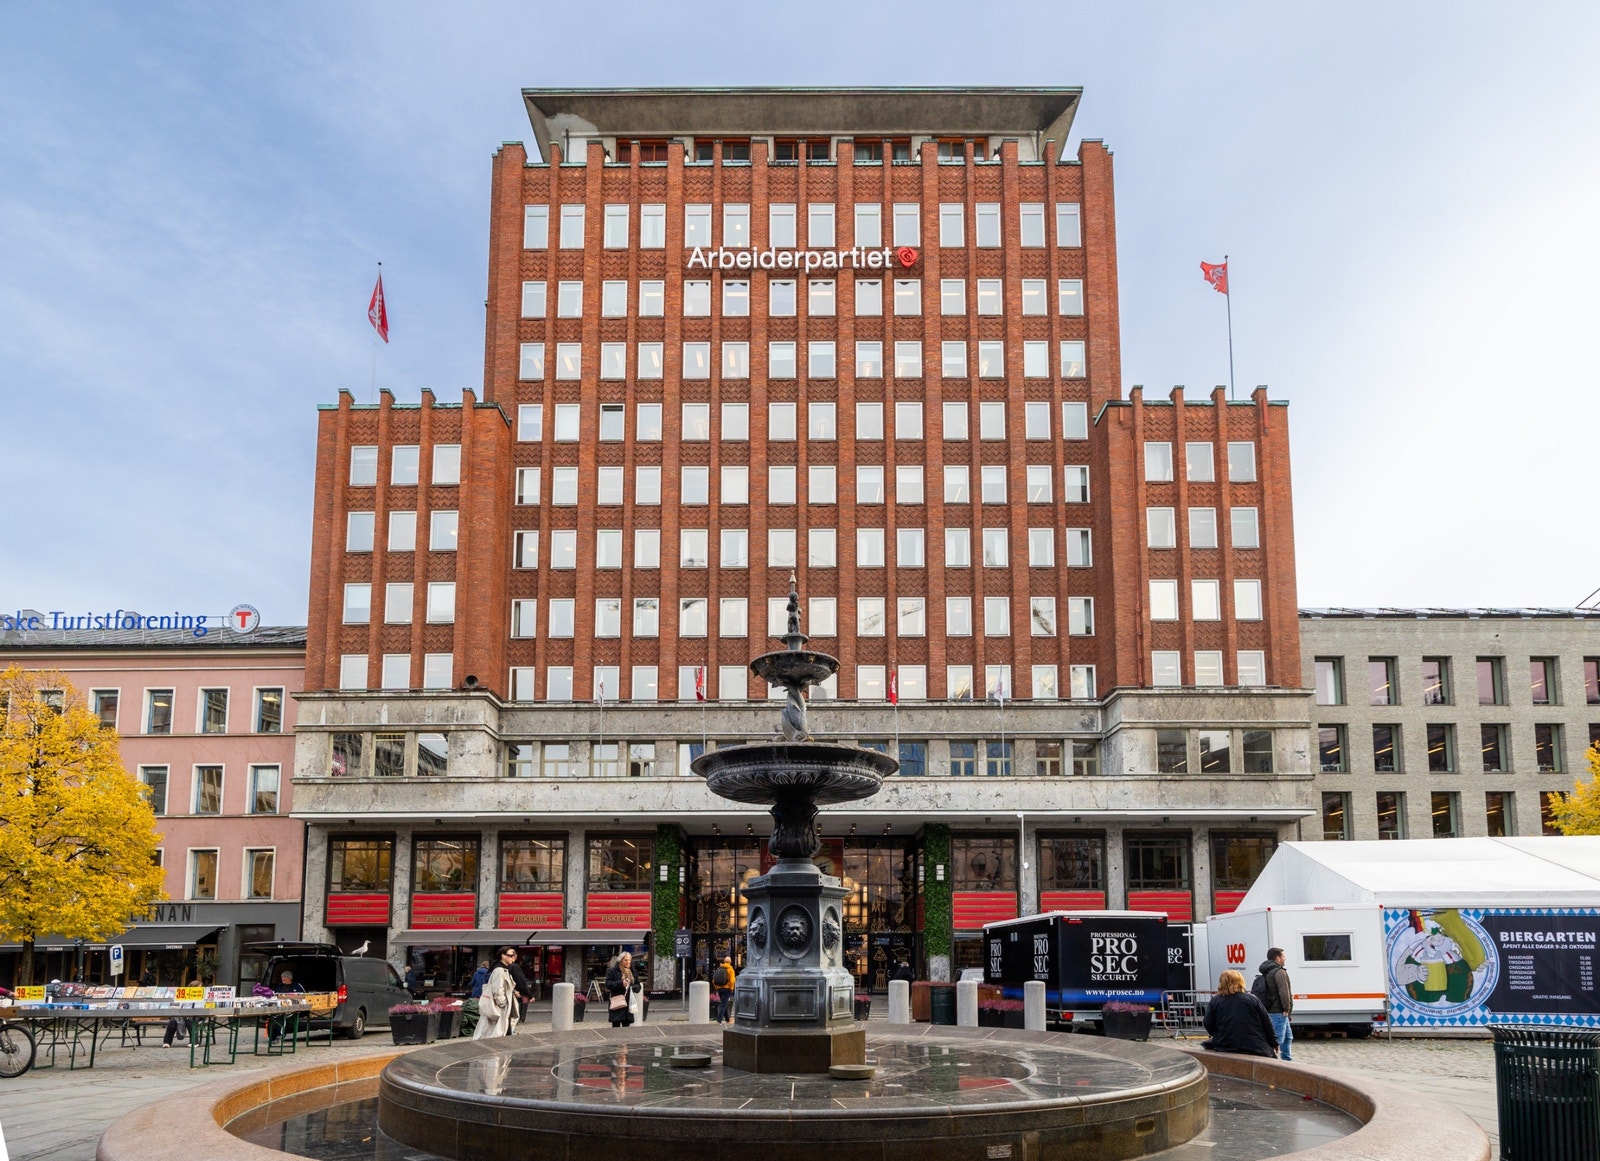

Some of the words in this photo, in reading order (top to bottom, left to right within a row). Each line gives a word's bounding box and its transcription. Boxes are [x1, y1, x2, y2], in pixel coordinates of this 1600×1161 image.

[687, 246, 892, 274] Arbeiderpartiet
[0, 610, 40, 631] ske
[49, 609, 208, 637] Turistforening
[513, 915, 548, 923] FISKERIET
[601, 915, 636, 923] FISKERIET
[1500, 931, 1596, 942] BIERGARTEN
[990, 943, 1002, 957] PRO
[1033, 938, 1049, 955] PRO
[1090, 937, 1137, 955] PRO
[1167, 947, 1183, 956] RO
[114, 949, 120, 959] P
[1167, 955, 1183, 964] EC
[1226, 943, 1246, 964] UCO
[990, 957, 1002, 972] SEC
[1033, 955, 1049, 973] SEC
[1090, 955, 1138, 974] SEC
[1085, 990, 1145, 998] www.prosec.no
